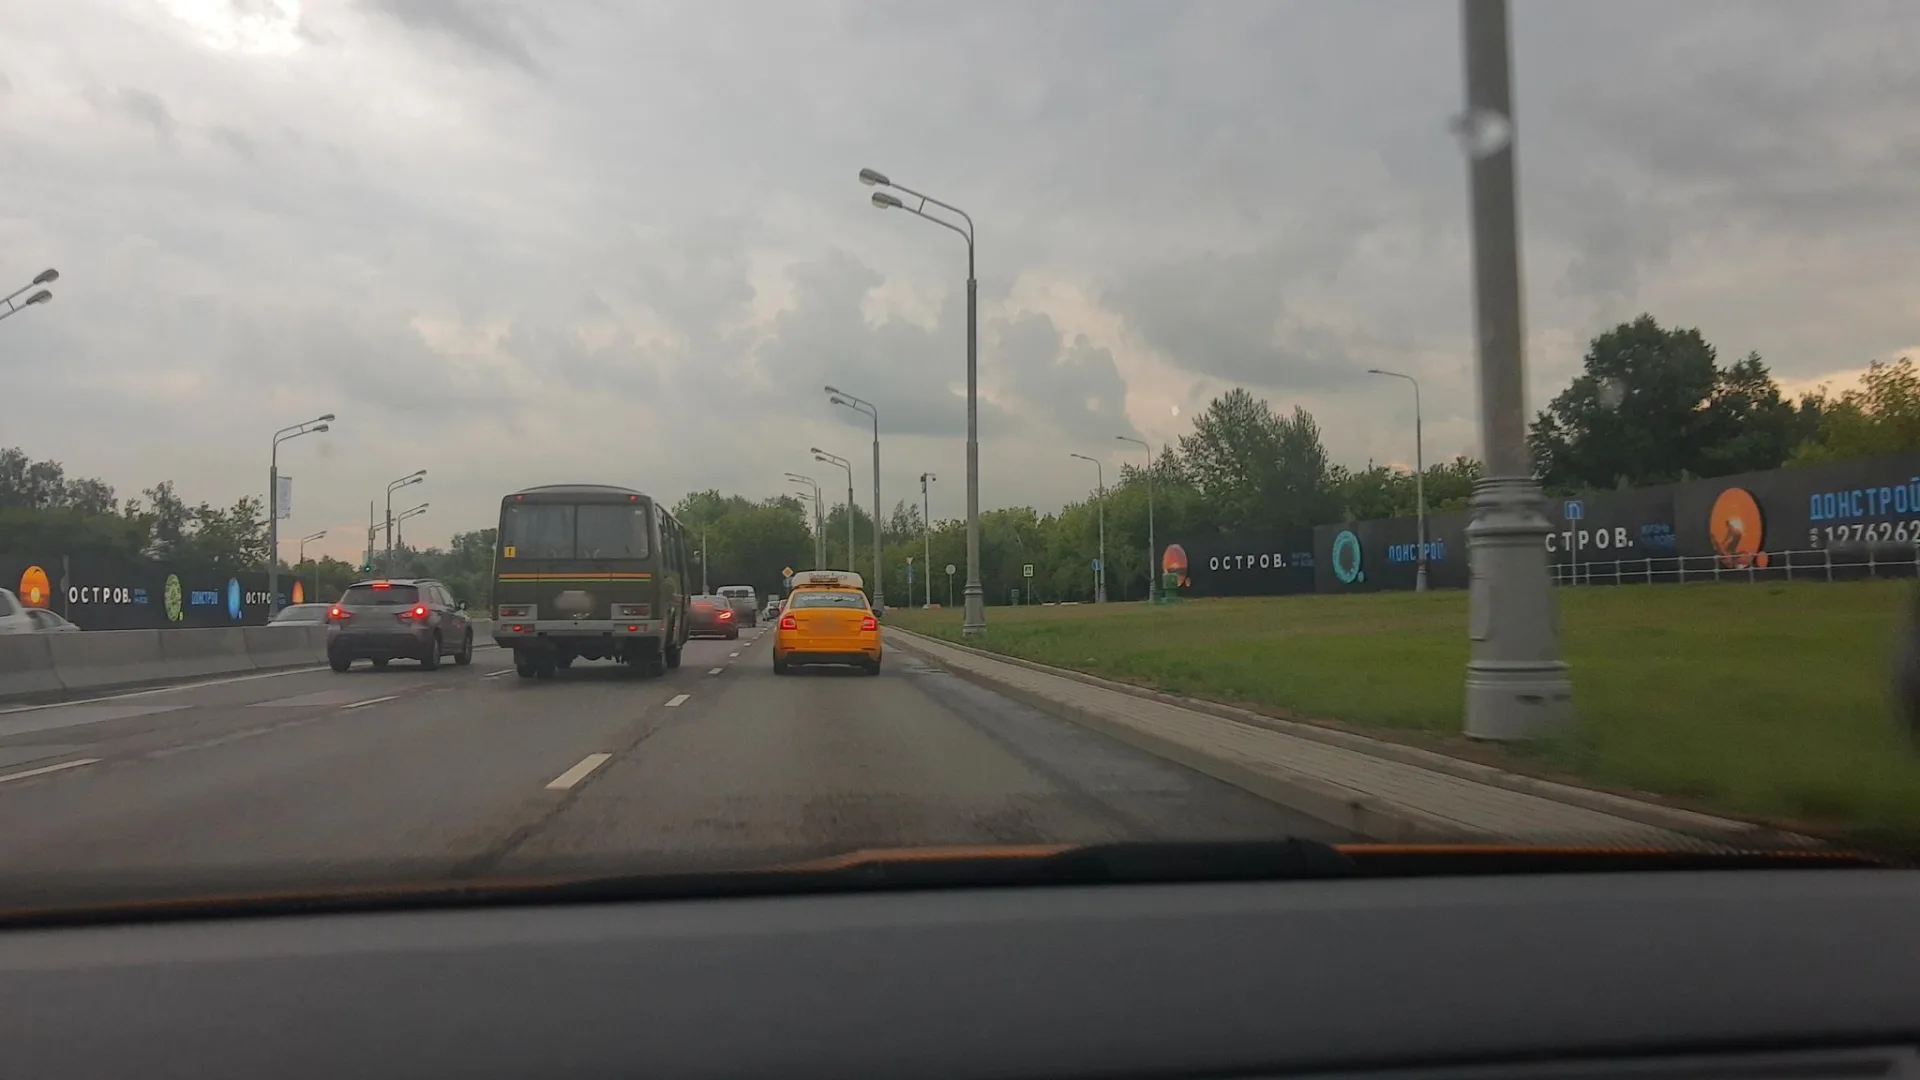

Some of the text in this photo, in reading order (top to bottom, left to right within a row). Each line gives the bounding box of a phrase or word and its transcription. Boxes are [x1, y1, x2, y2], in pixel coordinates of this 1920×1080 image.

[1810, 477, 1920, 520] ДОНСТРОЙ
[1545, 527, 1634, 552] СТРОВ.
[1209, 553, 1287, 571] ОСТРОВ.
[68, 586, 131, 604] ОСТРОВ.
